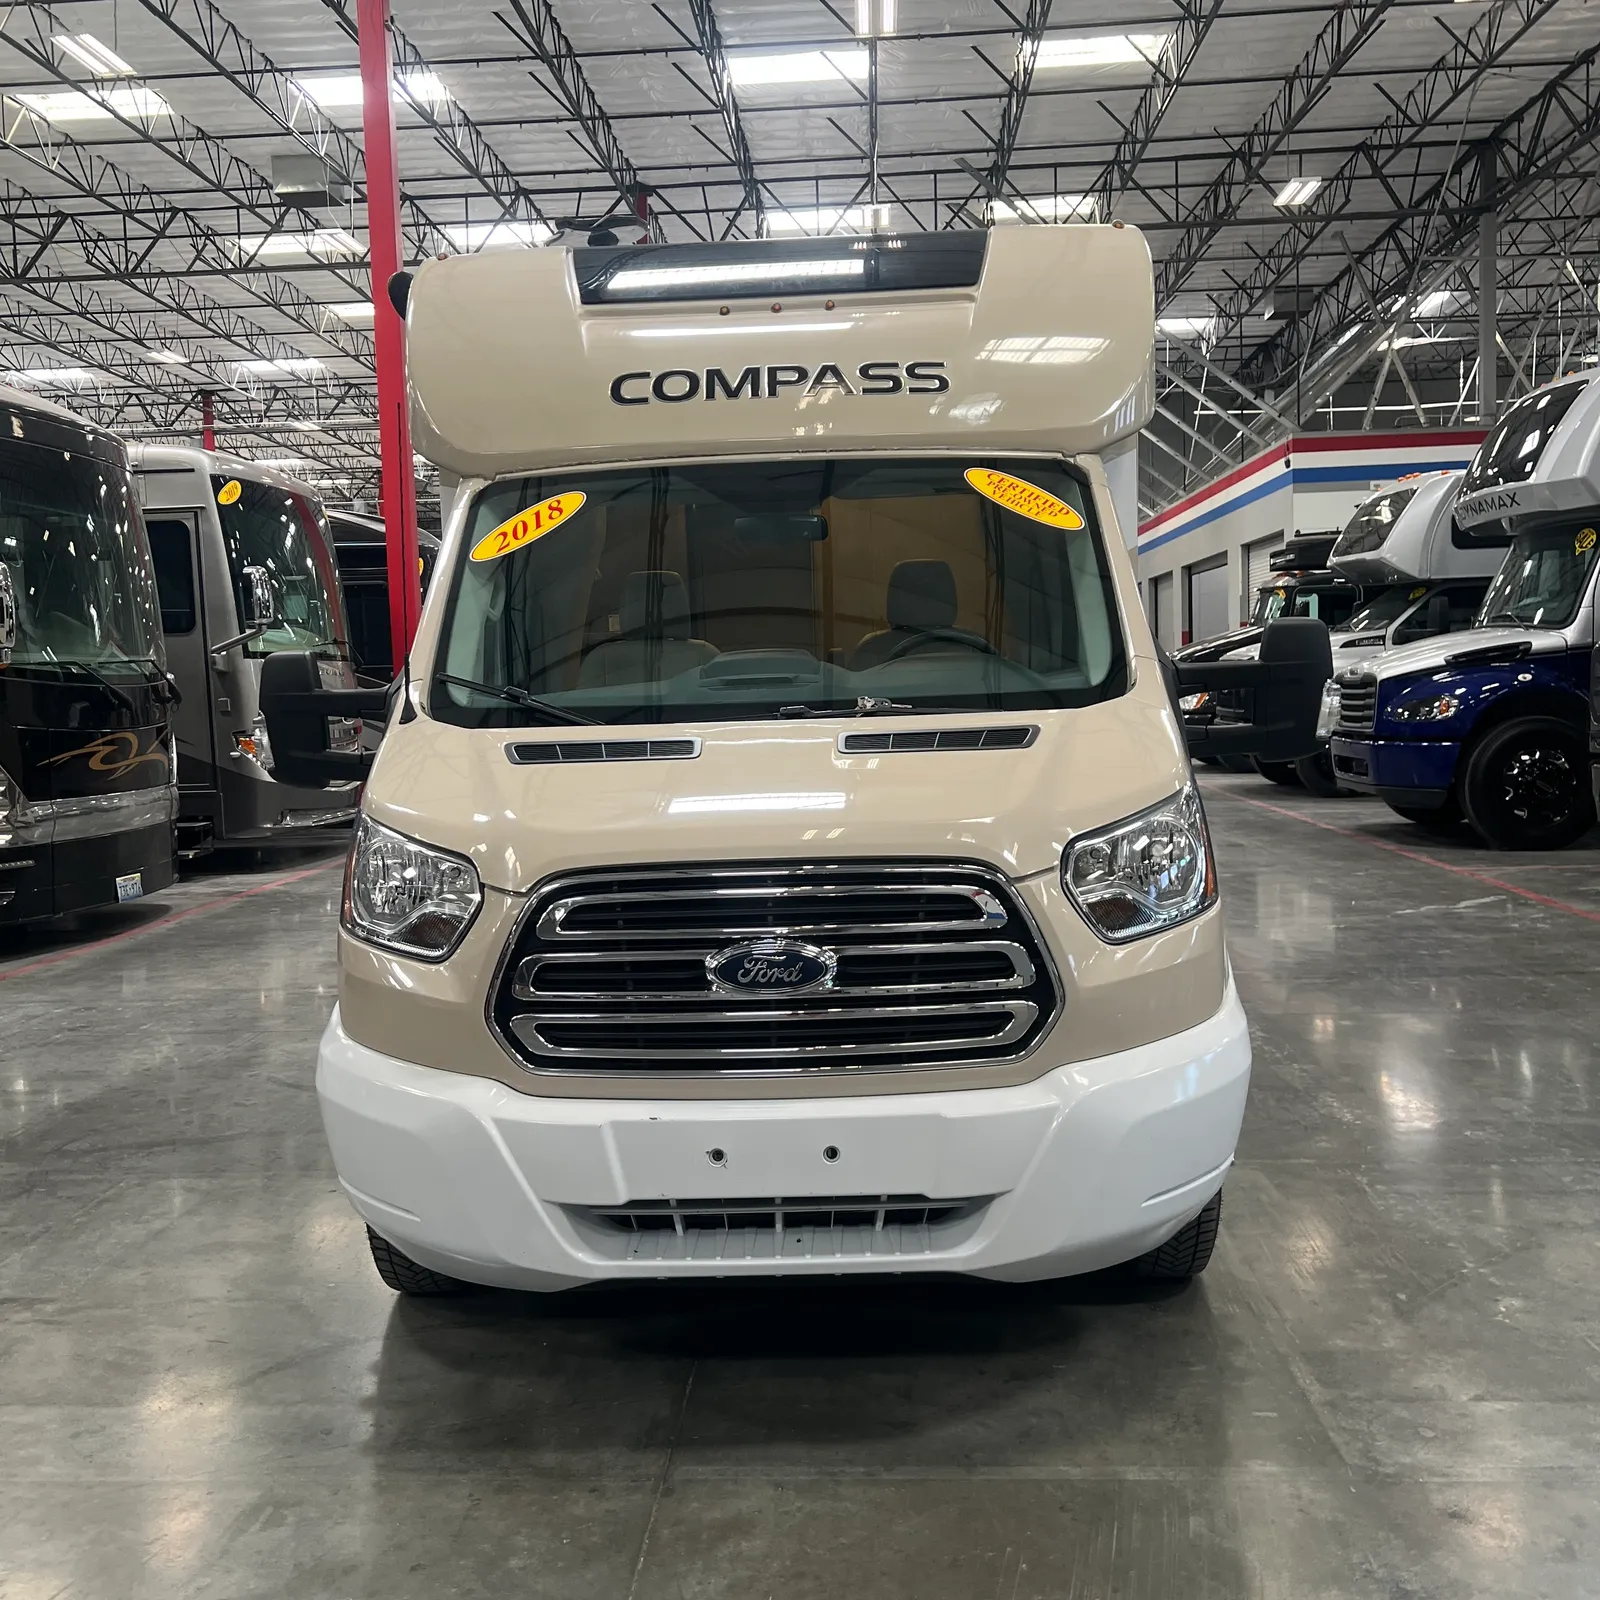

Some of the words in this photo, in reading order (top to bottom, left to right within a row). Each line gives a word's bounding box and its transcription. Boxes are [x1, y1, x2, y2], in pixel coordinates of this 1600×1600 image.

[608, 360, 952, 406] COMPASS
[986, 480, 1058, 518] PRE-OWNED
[987, 472, 1070, 516] CERTIFIED
[991, 489, 1043, 517] VEHICLE
[1459, 492, 1521, 520] DYNAMAX
[494, 499, 564, 554] 2018
[737, 955, 803, 983] Ford
